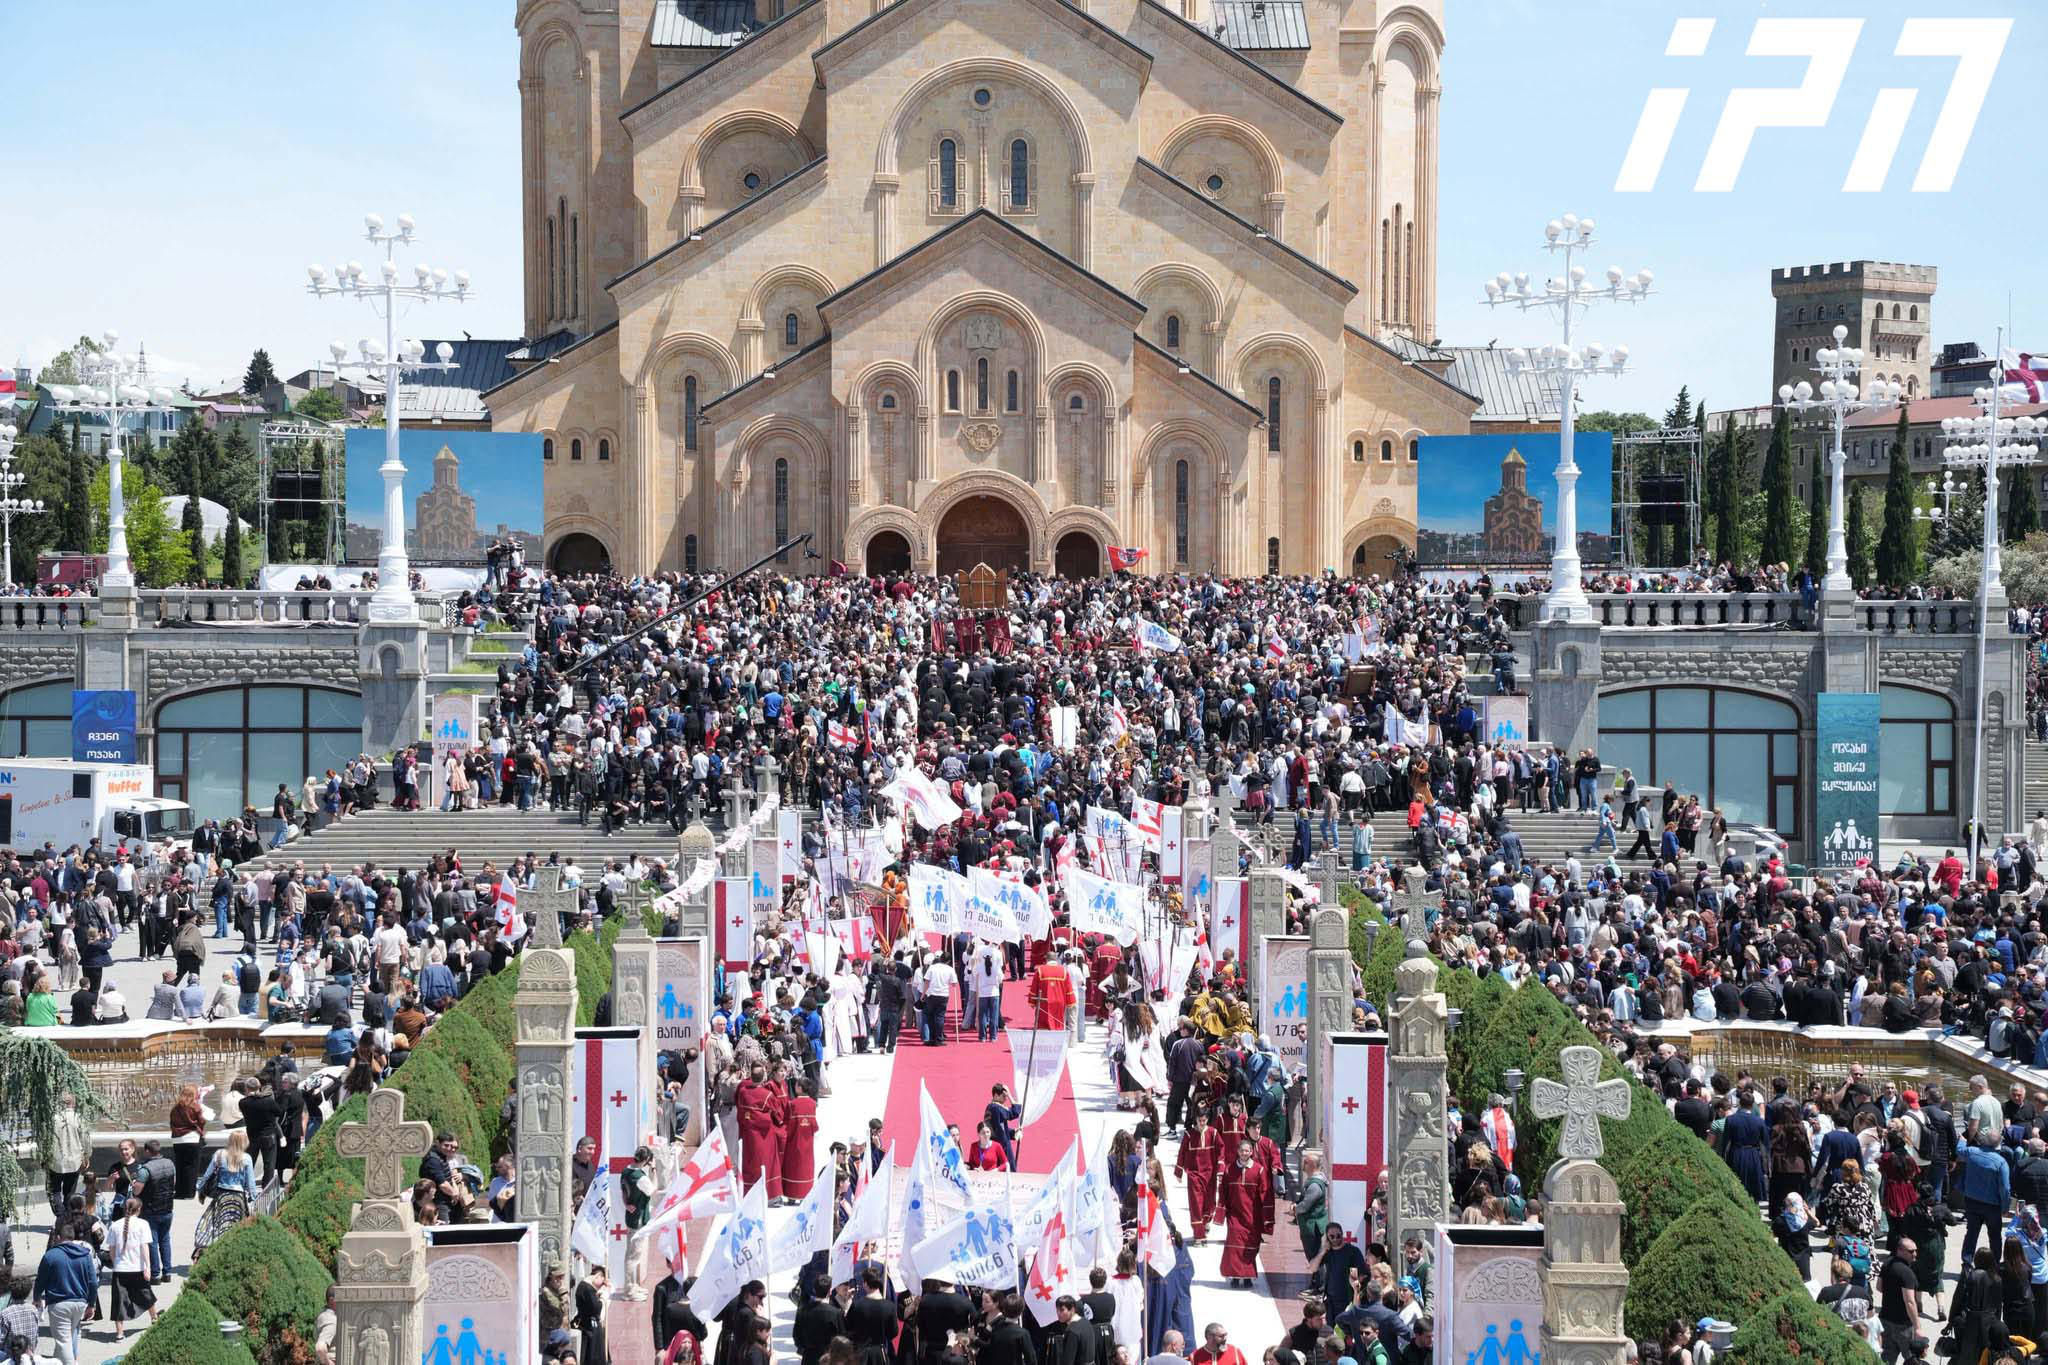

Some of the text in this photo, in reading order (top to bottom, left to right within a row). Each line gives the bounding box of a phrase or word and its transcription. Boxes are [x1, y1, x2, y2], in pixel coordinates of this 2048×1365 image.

[88, 732, 120, 741] ჩვენი
[1832, 743, 1867, 754] ოჯახი
[1833, 762, 1866, 773] მცირე
[1821, 780, 1876, 792] ეკლესიაა!
[657, 1026, 691, 1039] მაისი
[1275, 1024, 1288, 1037] 17
